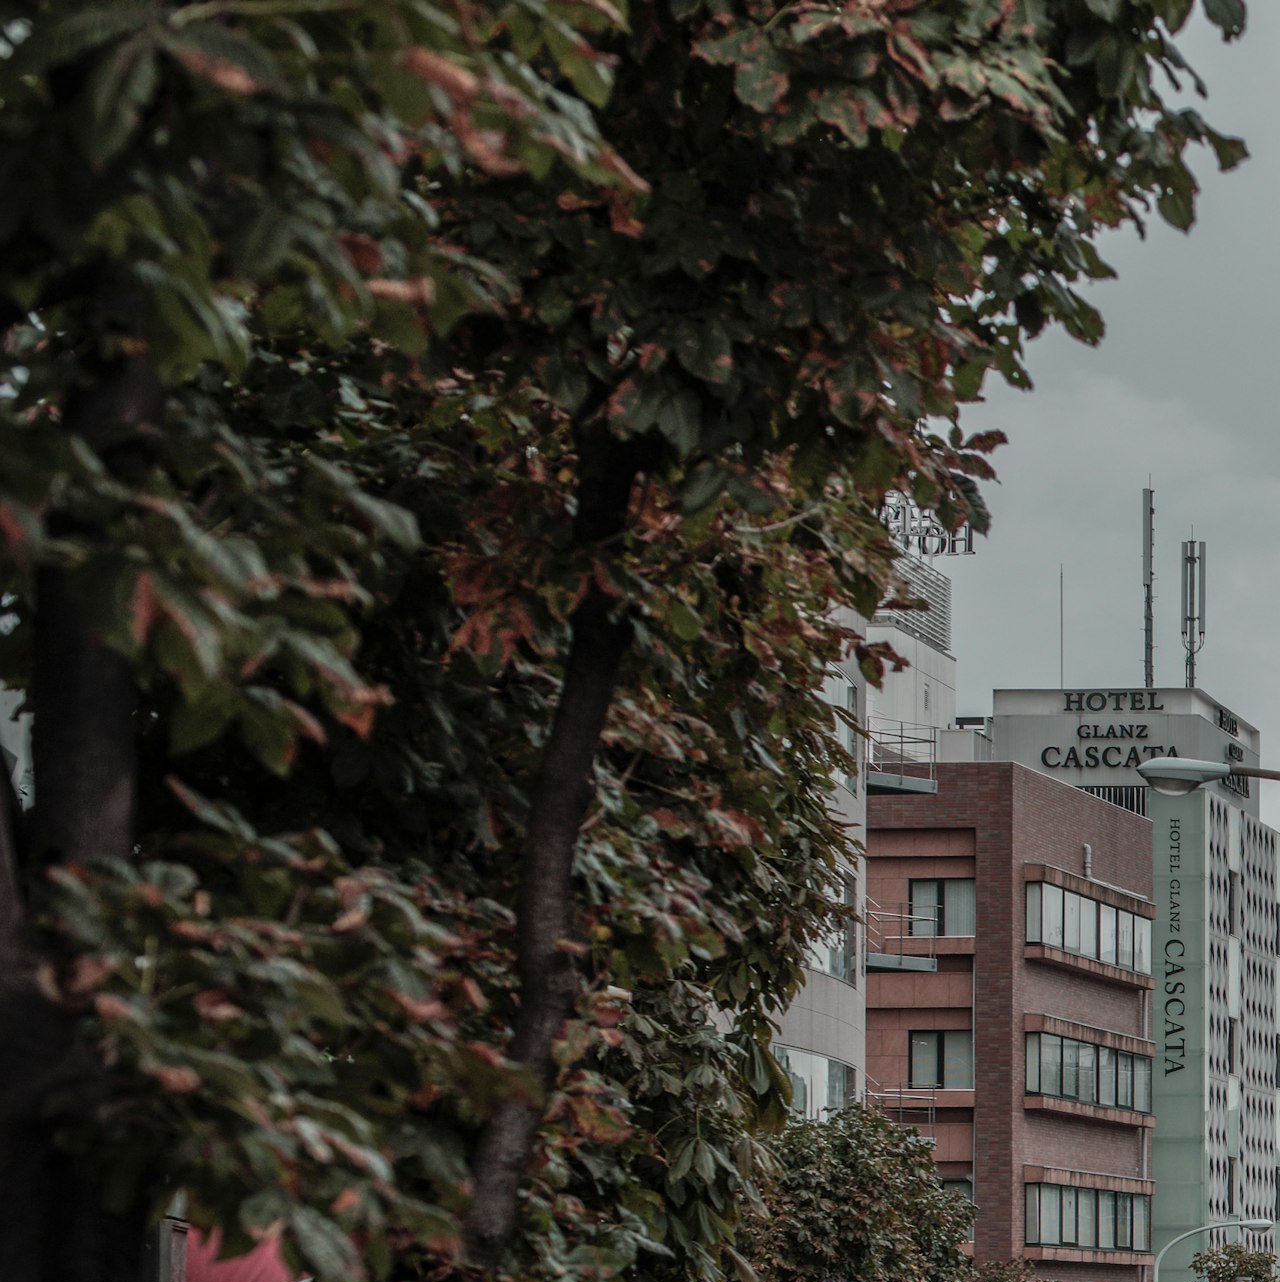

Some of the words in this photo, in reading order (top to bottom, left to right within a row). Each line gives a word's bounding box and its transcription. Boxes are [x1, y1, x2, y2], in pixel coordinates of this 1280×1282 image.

[1063, 691, 1164, 711] HOTEL
[1077, 724, 1149, 739] GLANZ
[1169, 819, 1181, 873] HOTEL
[1169, 879, 1181, 933] GLANZ
[1164, 938, 1186, 1078] CASCATA
